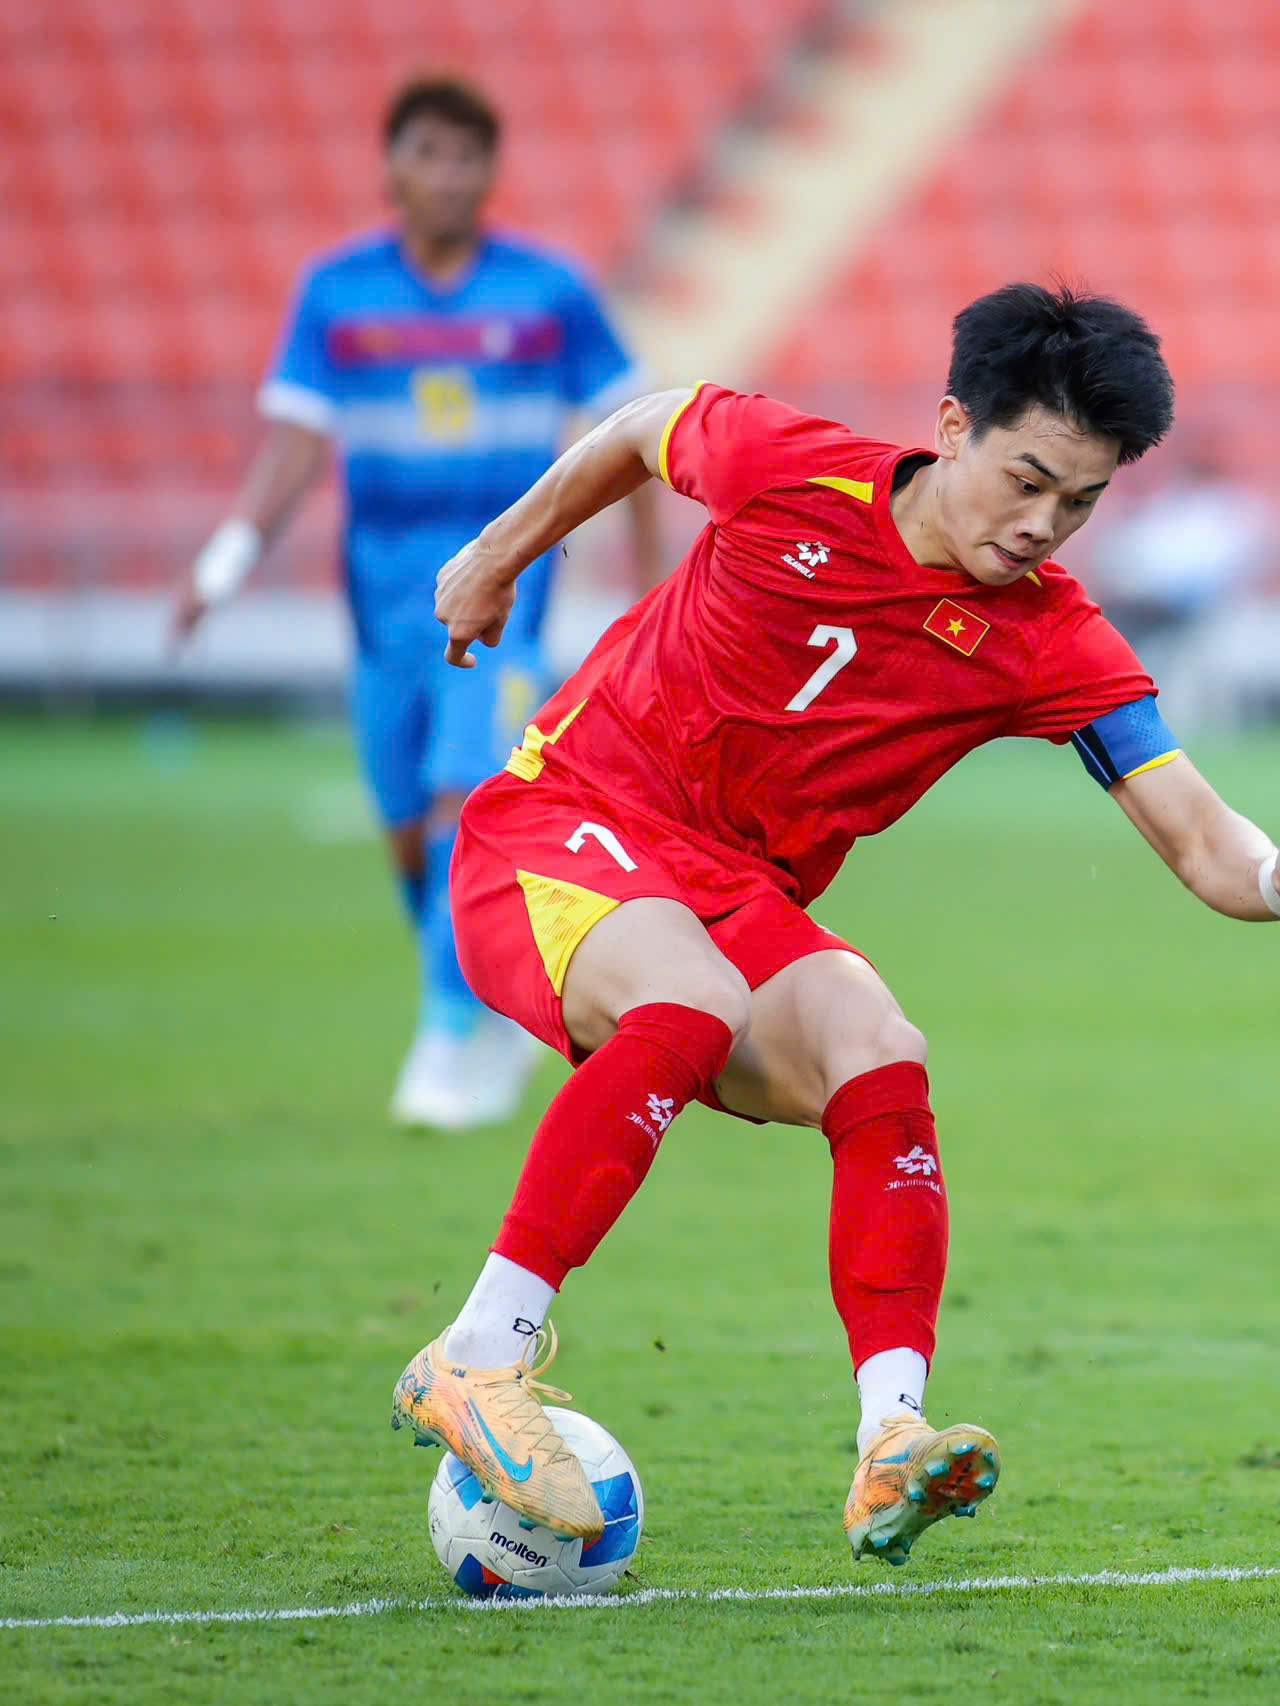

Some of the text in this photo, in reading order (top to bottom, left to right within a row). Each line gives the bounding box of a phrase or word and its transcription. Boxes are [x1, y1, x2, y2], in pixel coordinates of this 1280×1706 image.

[784, 623, 859, 712] 7
[563, 821, 639, 873] 7
[490, 1531, 548, 1568] molten
